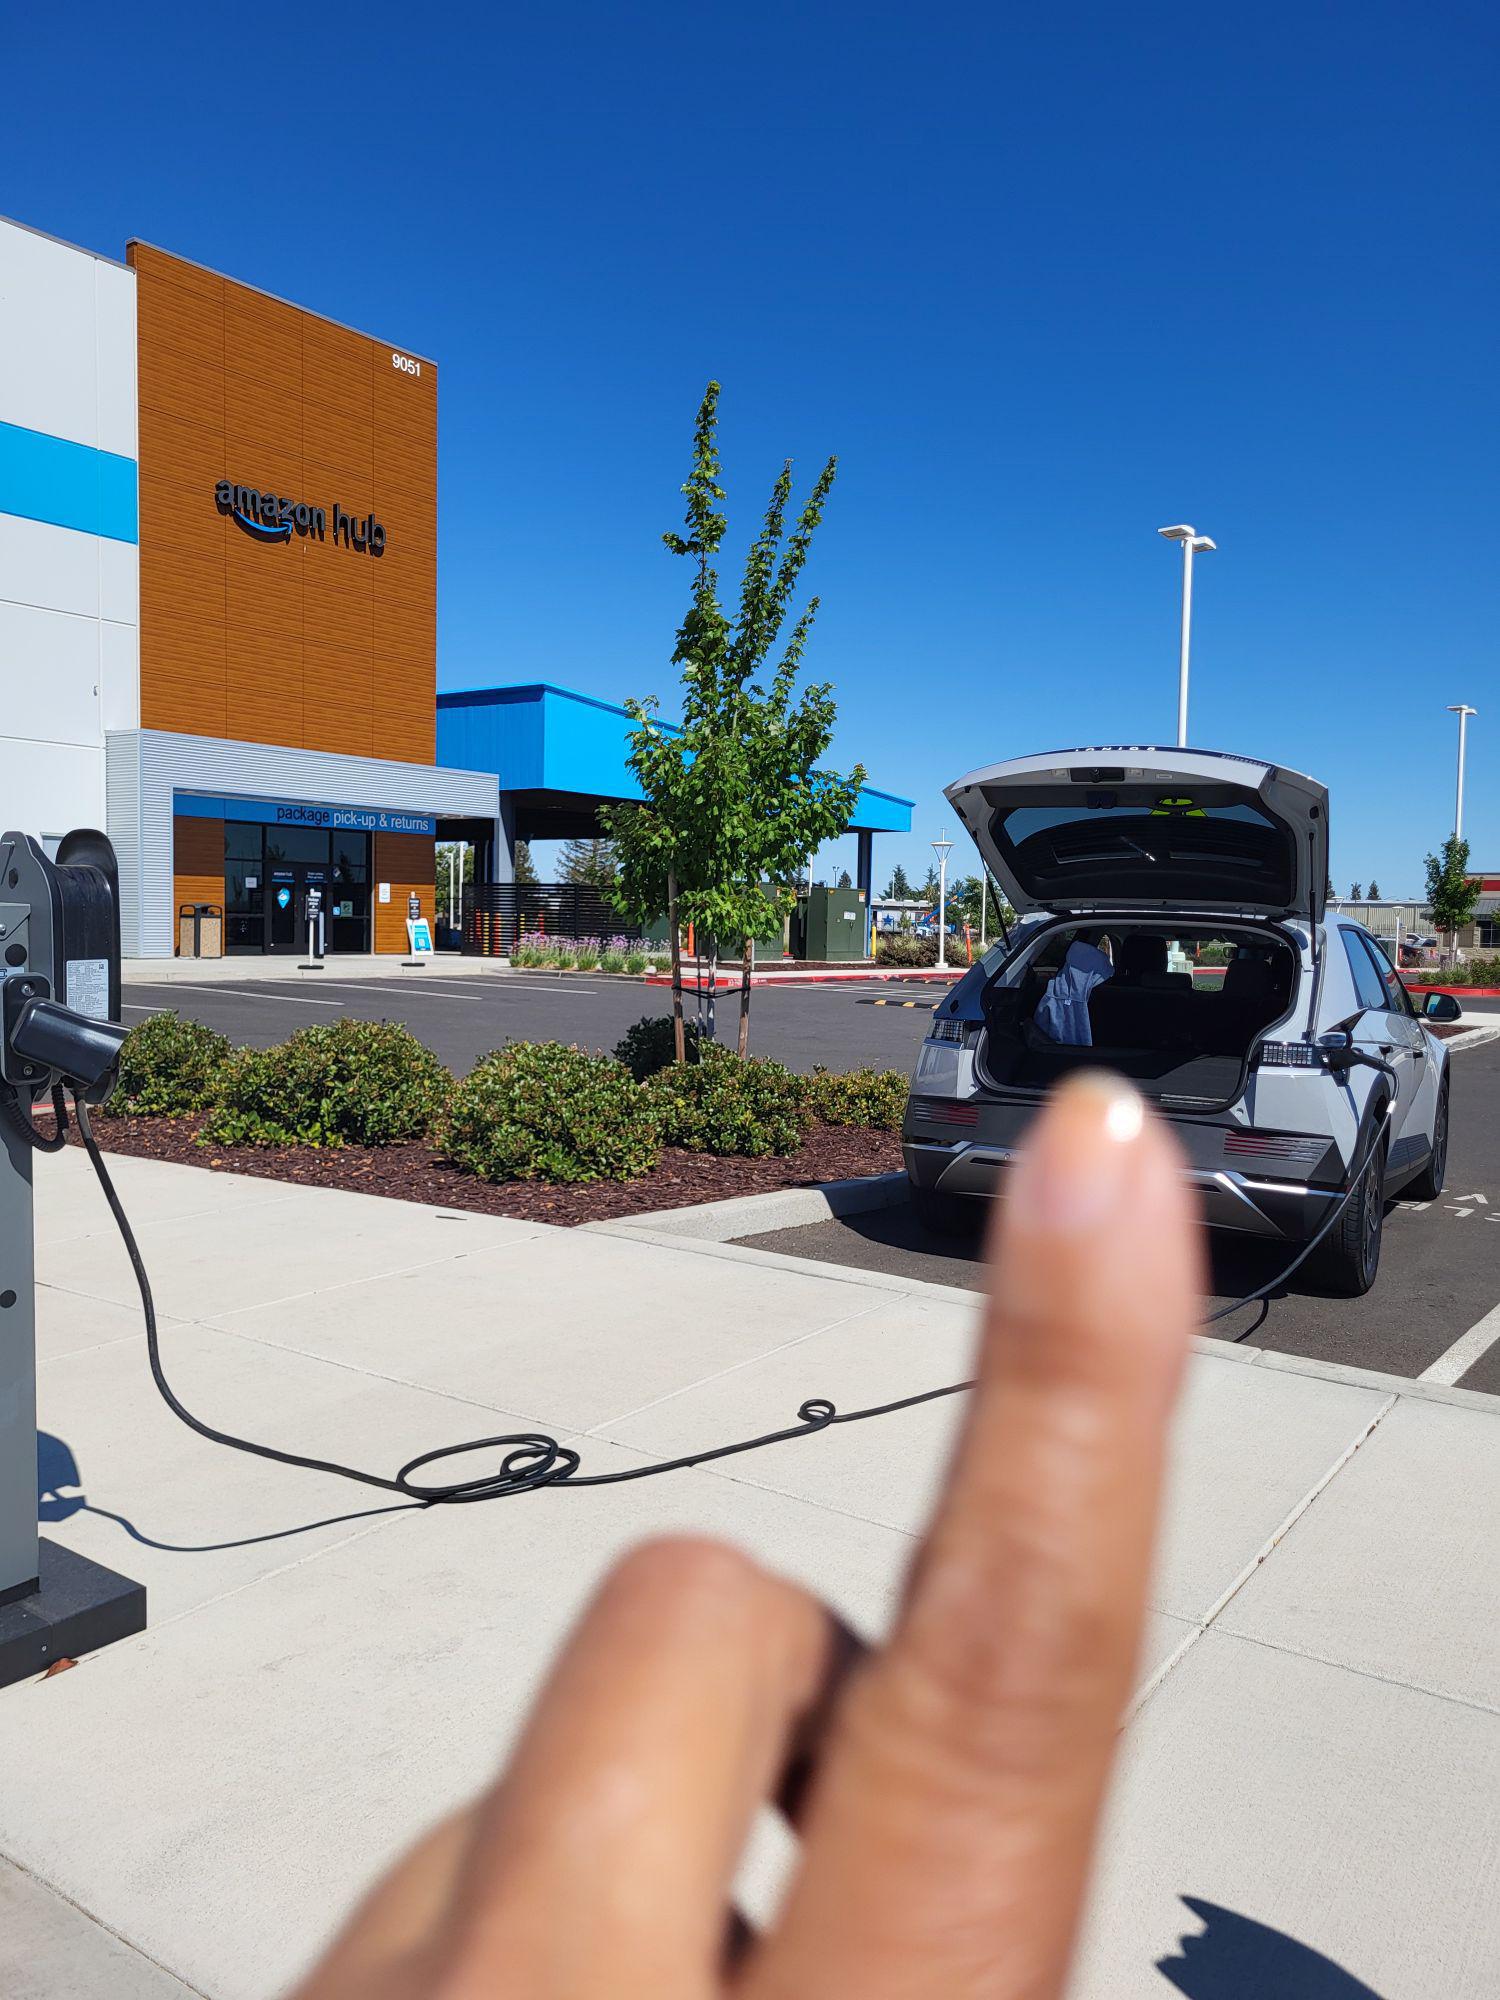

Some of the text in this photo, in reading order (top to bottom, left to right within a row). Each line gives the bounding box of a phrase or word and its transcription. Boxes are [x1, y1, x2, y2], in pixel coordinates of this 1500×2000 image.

[392, 353, 421, 377] 9051
[215, 479, 387, 549] amazon hub
[276, 806, 429, 831] package pick-up & returns
